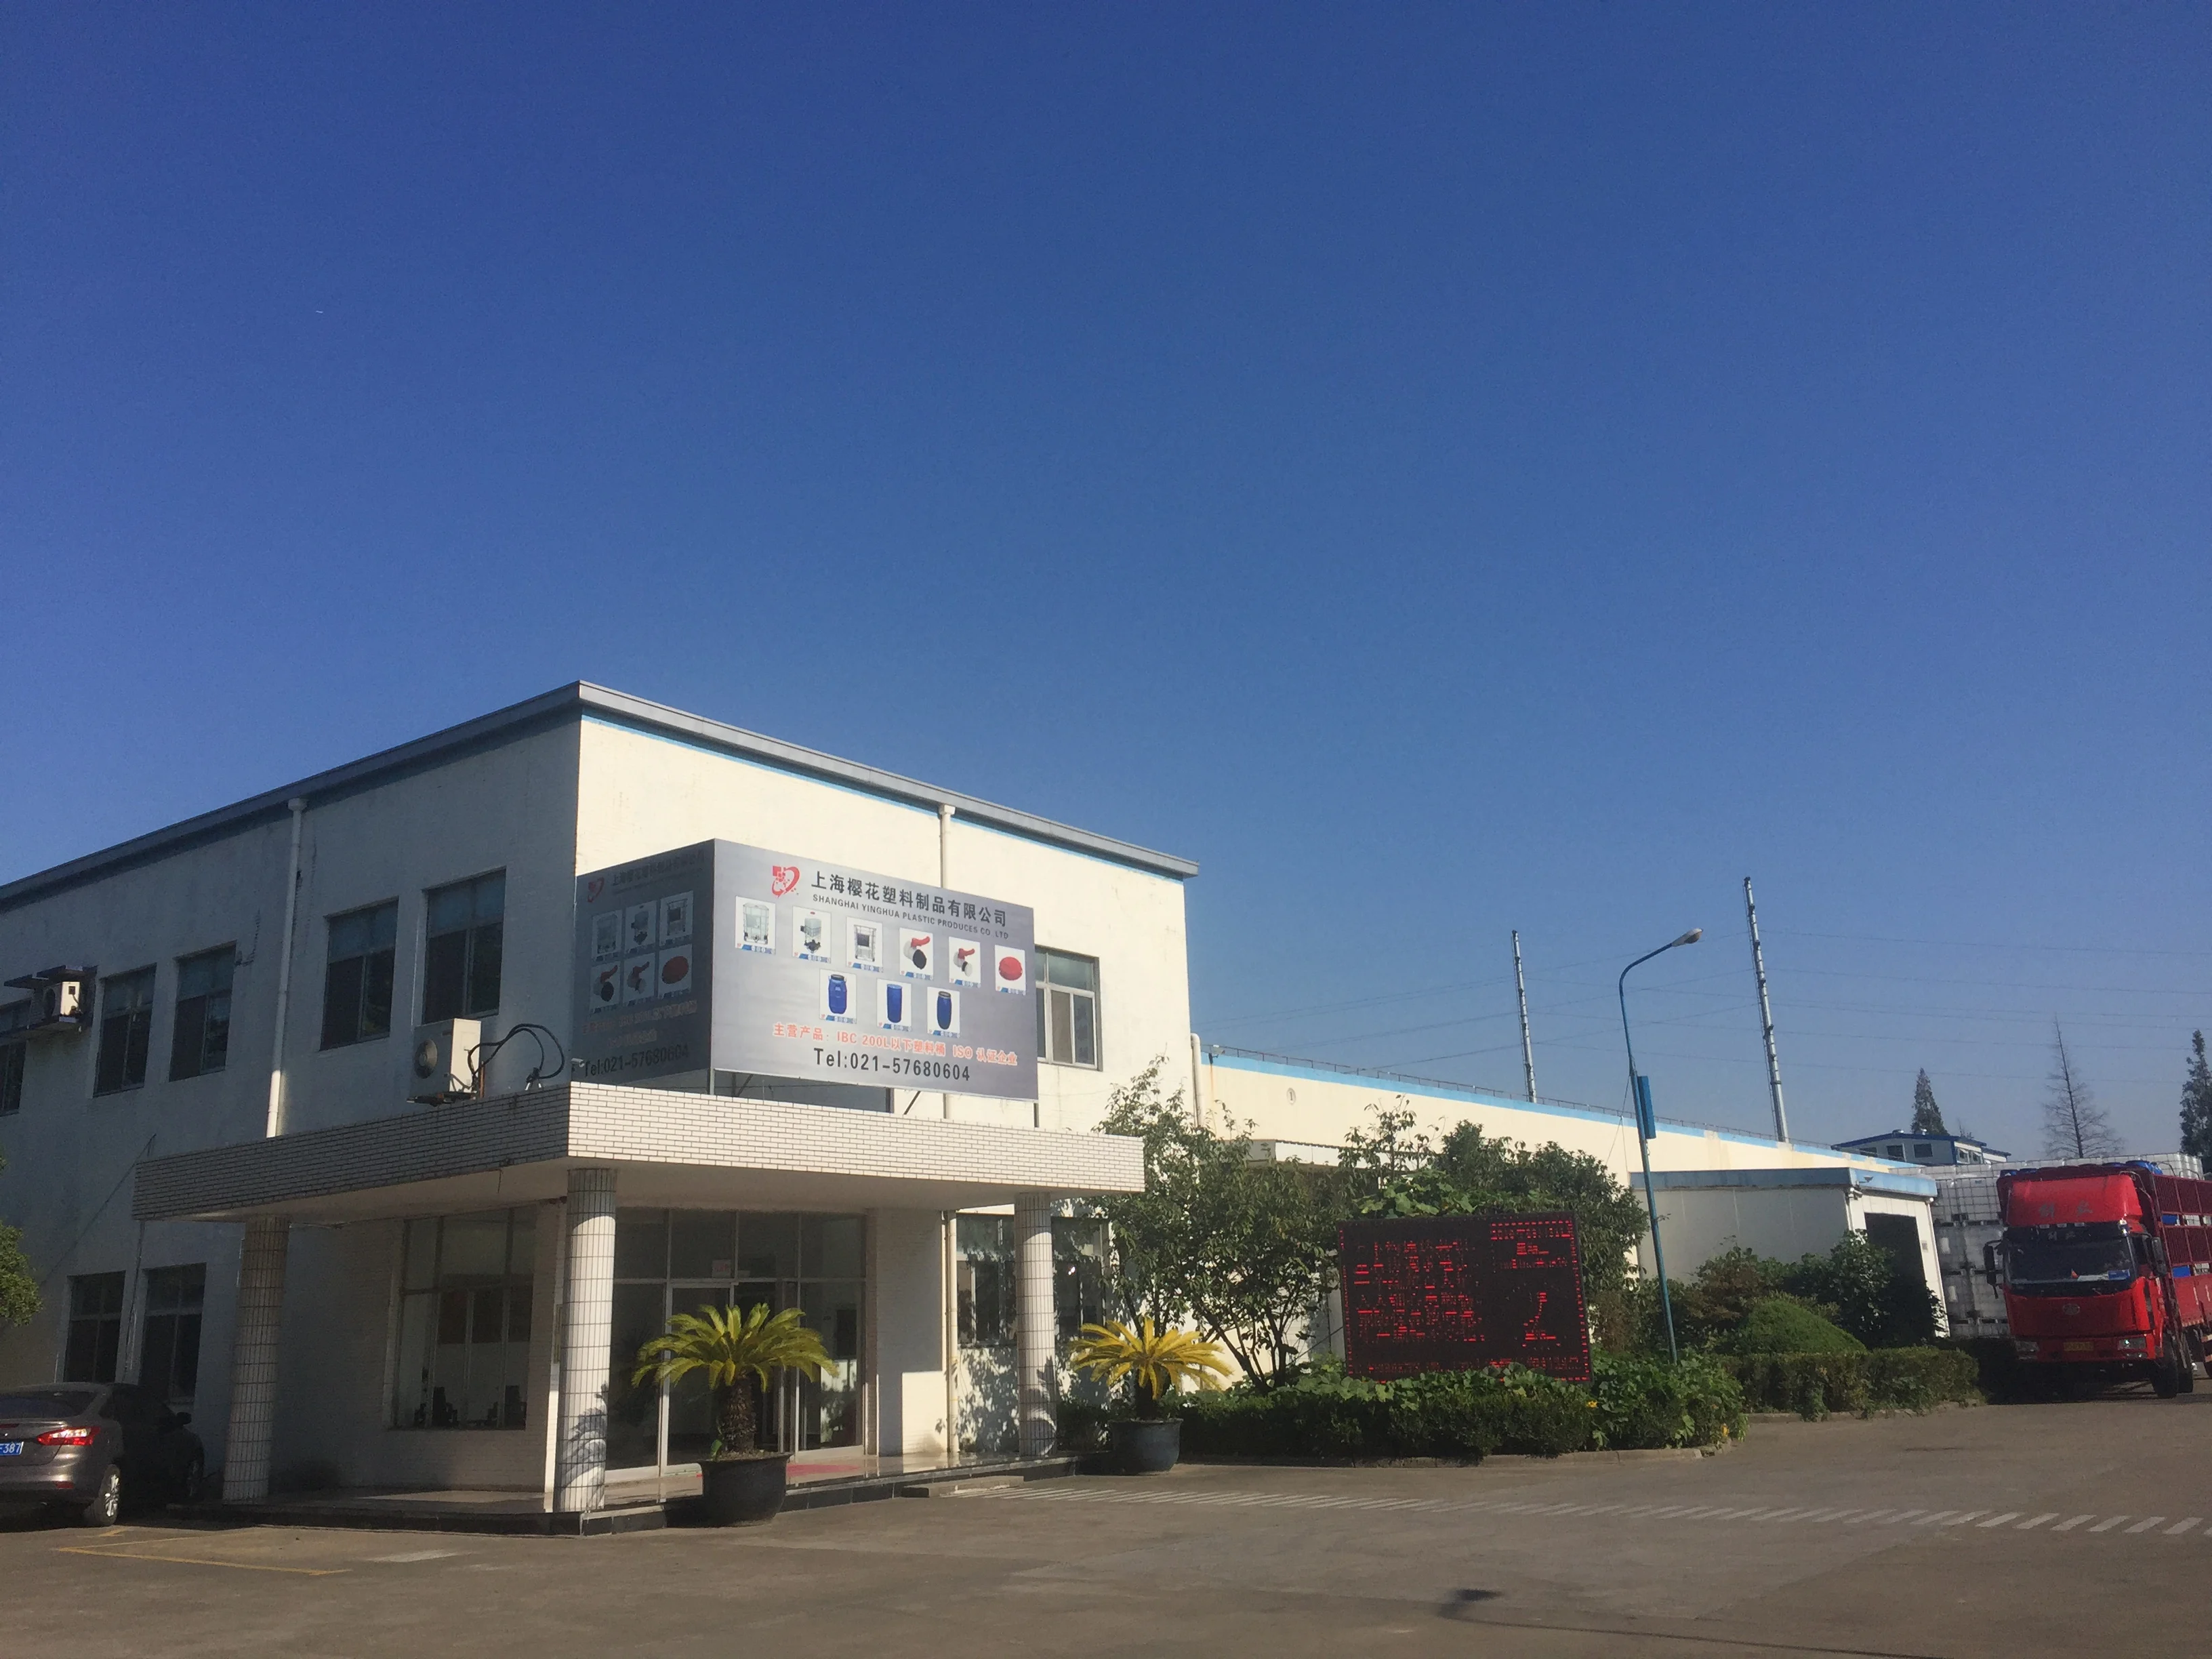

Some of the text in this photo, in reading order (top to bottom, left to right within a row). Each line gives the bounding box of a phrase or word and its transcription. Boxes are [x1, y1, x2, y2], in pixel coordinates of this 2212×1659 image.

[811, 871, 1006, 927] 上海樱花塑料制品有限公司
[813, 894, 859, 910] SHANGHAI
[861, 903, 900, 918] YINGHUA
[903, 912, 935, 924] PLASTIC
[937, 918, 978, 933] PRODUCES
[814, 1048, 970, 1081] Tel:021-57680604
[837, 1031, 857, 1044] IBC
[953, 1045, 973, 1059] ISO
[977, 1048, 1017, 1065] 认证企业
